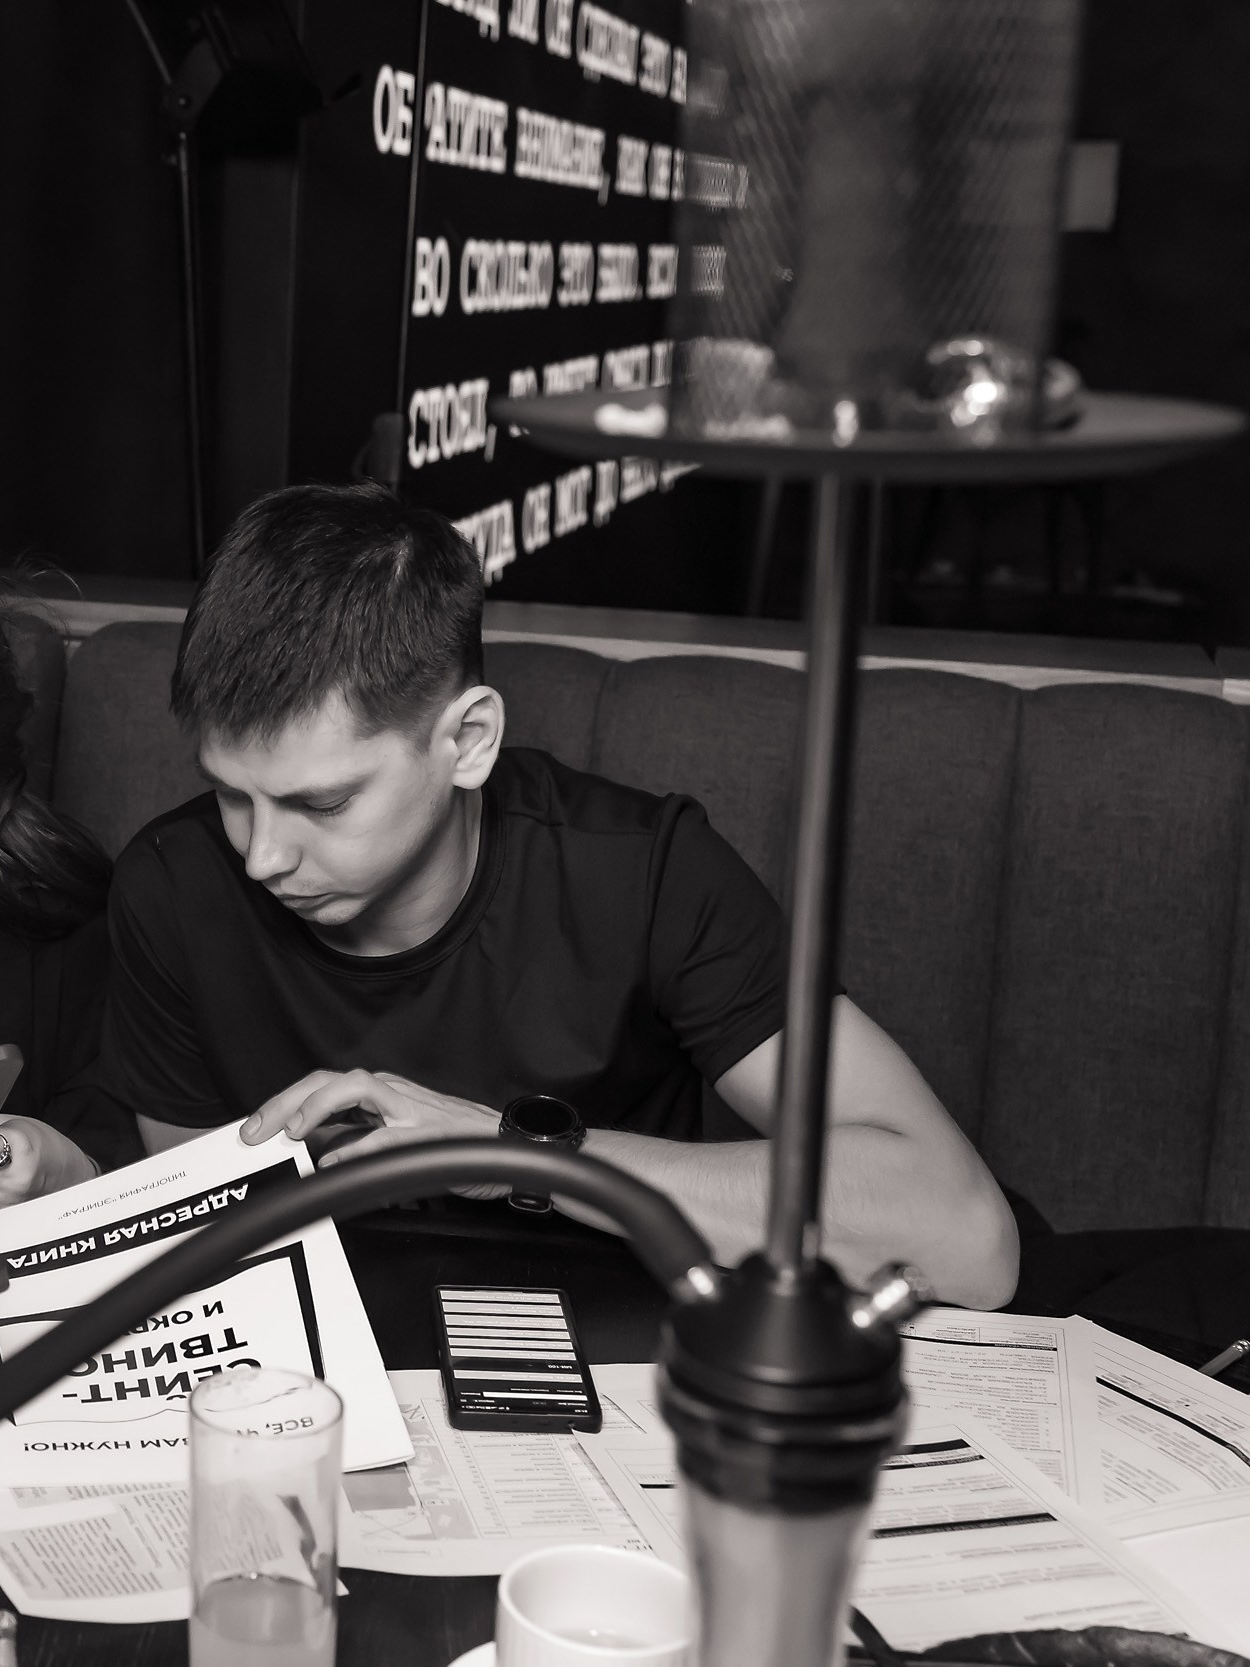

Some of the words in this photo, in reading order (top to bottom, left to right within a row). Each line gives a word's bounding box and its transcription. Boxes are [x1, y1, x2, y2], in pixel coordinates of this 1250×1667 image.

[411, 236, 450, 316] ВО
[460, 238, 554, 315] СКОЛЬКО
[556, 240, 596, 307] ЭТО
[119, 1170, 187, 1202] ТИПОГРАФИЯ
[58, 1195, 118, 1221] "ЭПИГРАФ"
[104, 1182, 249, 1246] АДРЕСНАЯ
[6, 1236, 97, 1269] КНИГА
[124, 1309, 194, 1336] ОКР
[203, 1300, 224, 1318] И
[23, 1440, 131, 1452] НУЖНО!
